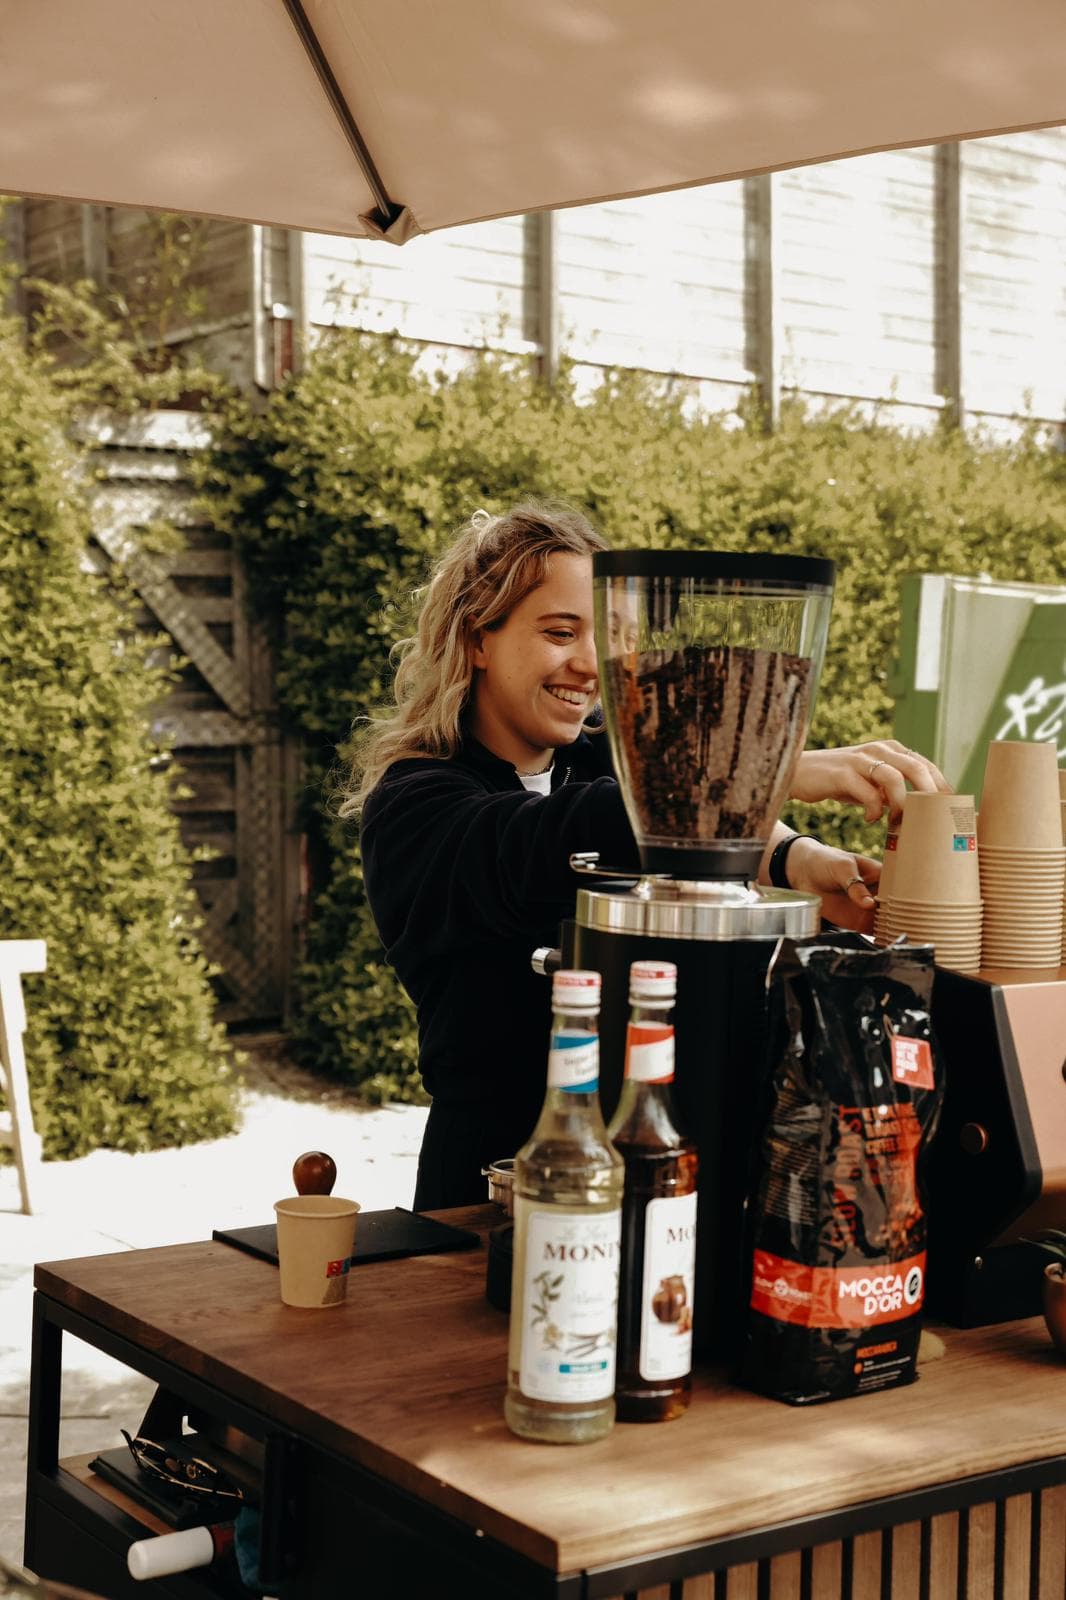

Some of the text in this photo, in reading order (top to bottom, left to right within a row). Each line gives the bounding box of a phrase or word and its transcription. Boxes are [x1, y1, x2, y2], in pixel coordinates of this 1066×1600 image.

[831, 1104, 861, 1248] SLOW ROAST
[838, 1274, 904, 1299] MOCCA
[863, 1290, 903, 1316] D'OR
